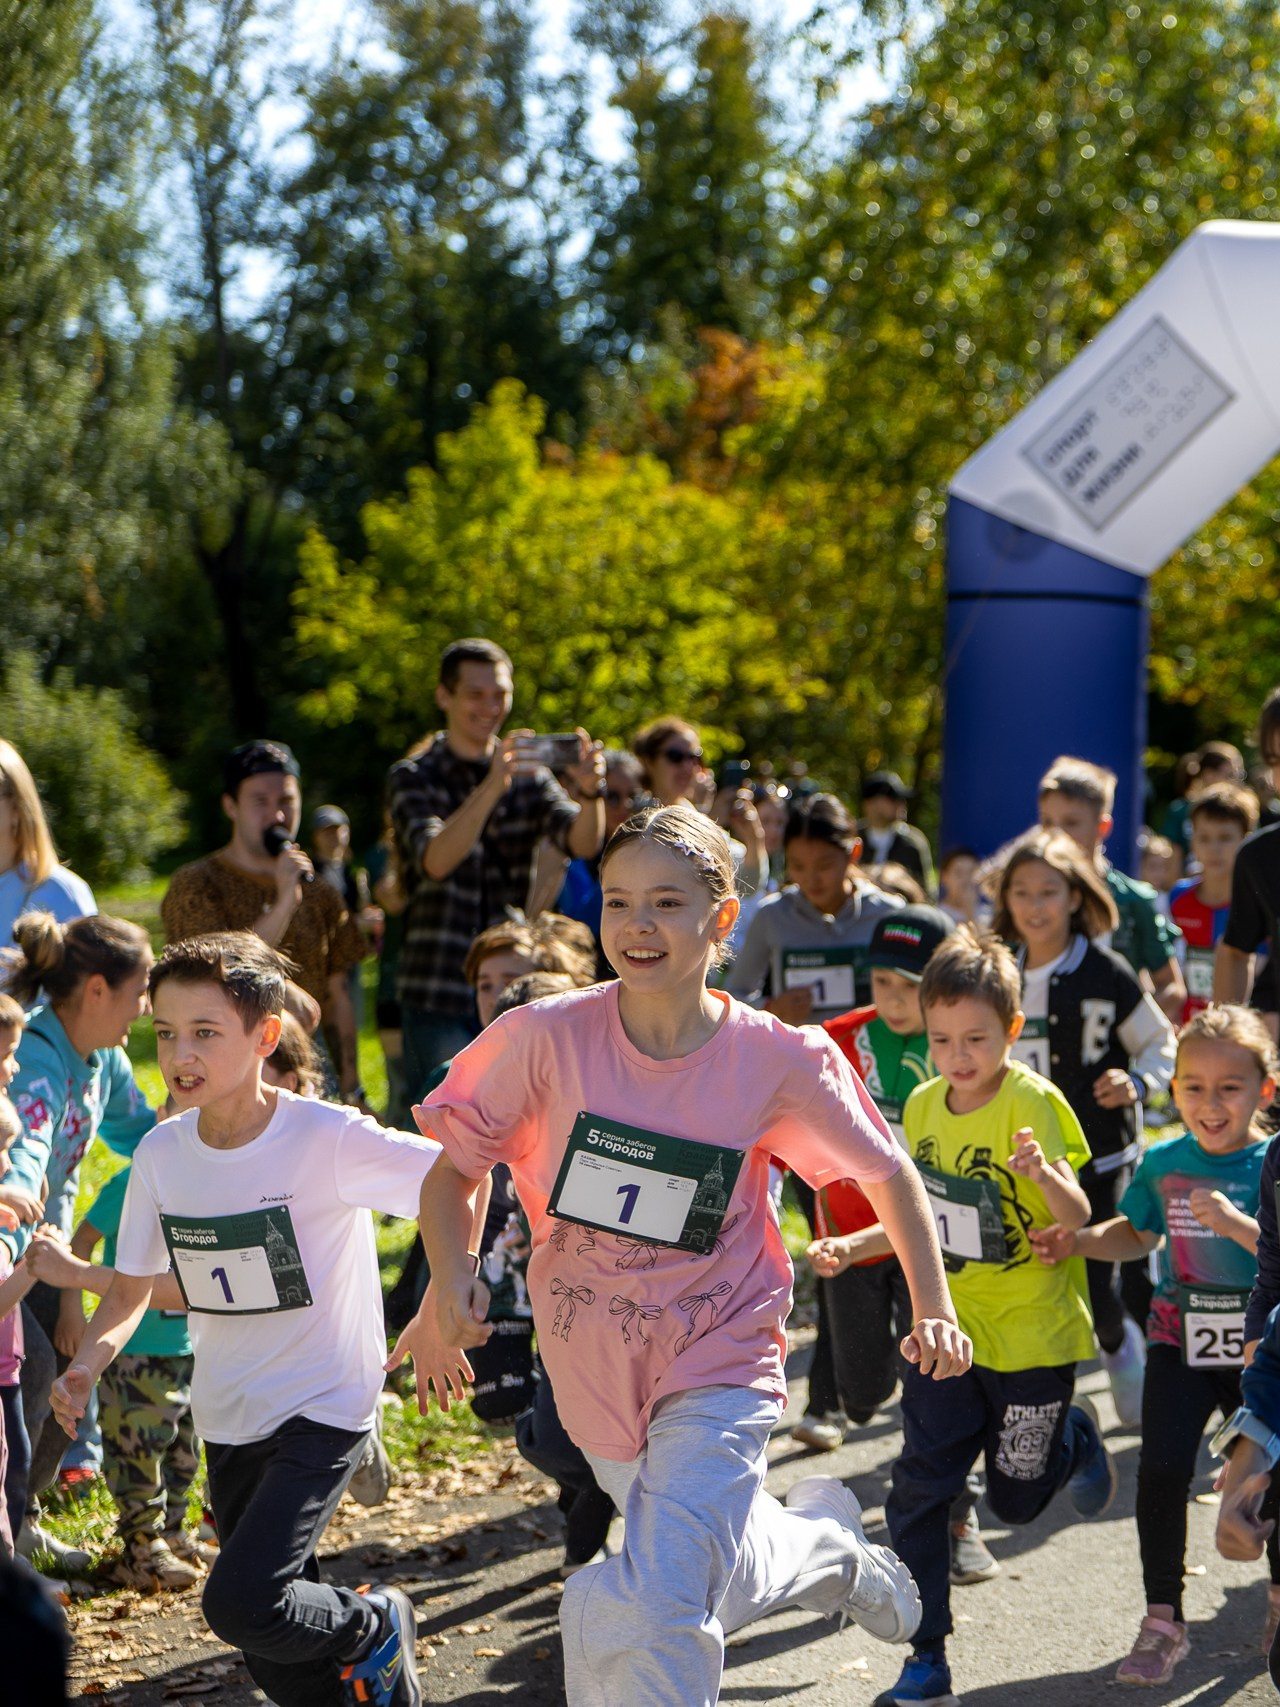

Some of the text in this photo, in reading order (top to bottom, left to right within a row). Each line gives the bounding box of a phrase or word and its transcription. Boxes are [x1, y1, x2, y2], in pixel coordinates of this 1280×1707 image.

[587, 1129, 654, 1160] 5 городов
[602, 1132, 656, 1152] серия забегов
[616, 1183, 641, 1224] 1
[171, 1226, 219, 1245] 5 городов
[939, 1213, 949, 1245] 1
[211, 1267, 235, 1304] 1
[1189, 1293, 1199, 1308] 5
